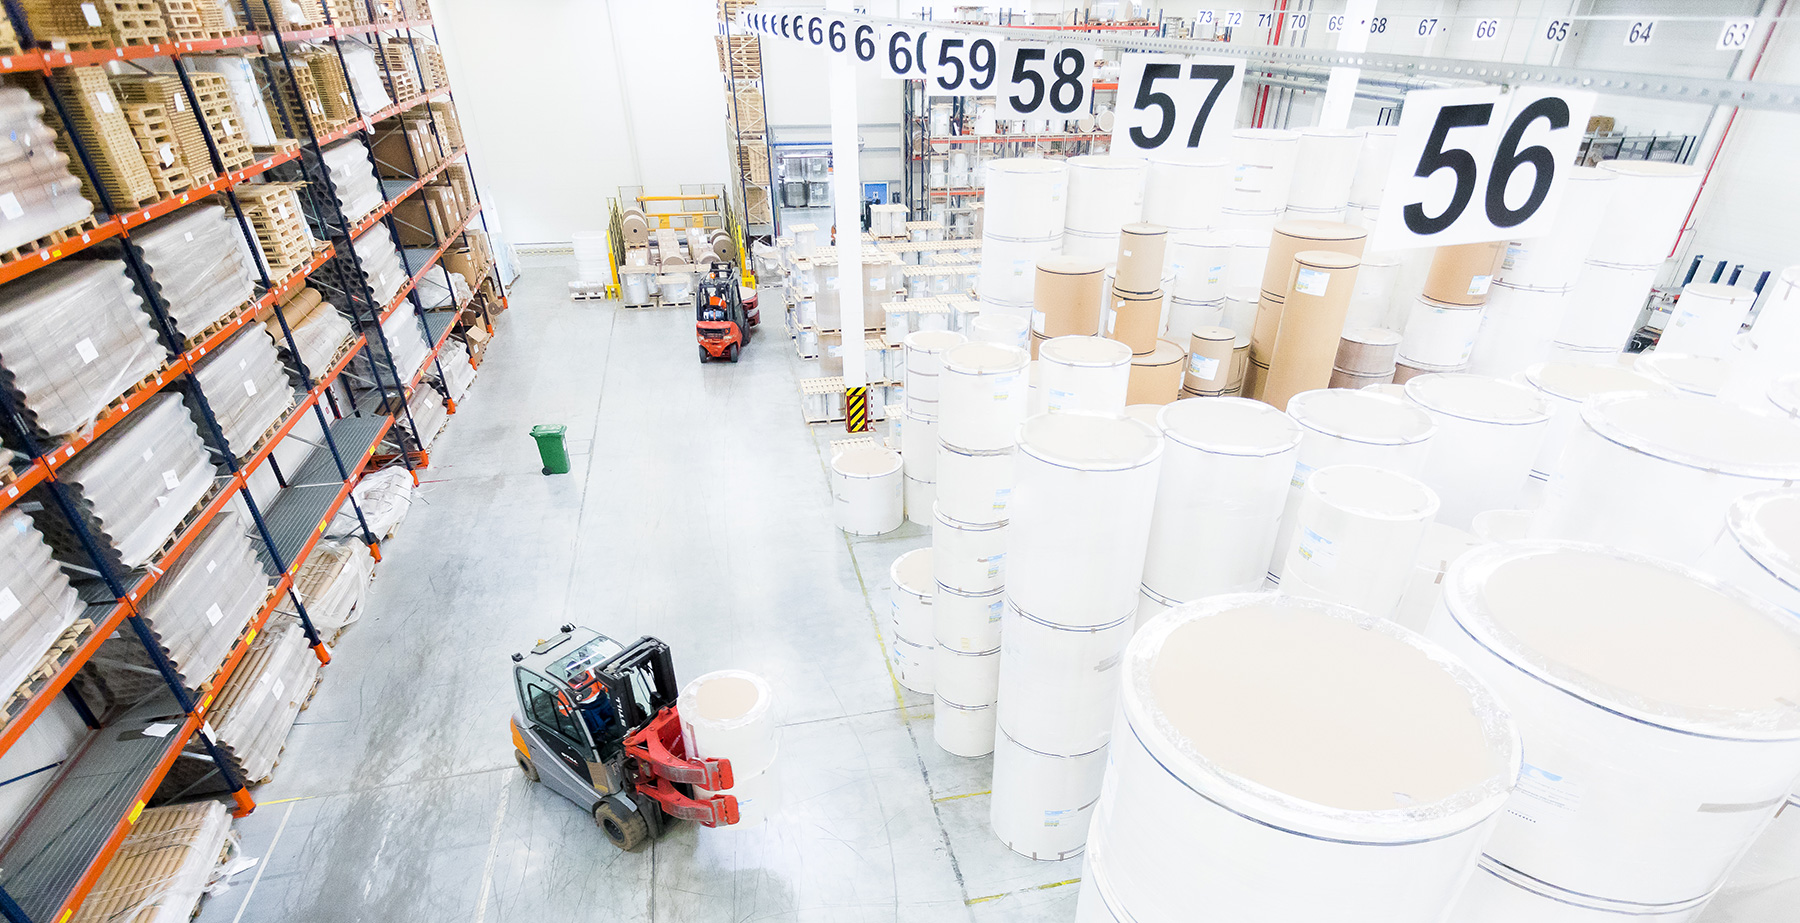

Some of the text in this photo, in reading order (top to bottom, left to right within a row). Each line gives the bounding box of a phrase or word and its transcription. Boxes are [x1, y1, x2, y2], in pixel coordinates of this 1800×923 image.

[1199, 11, 1213, 23] 73
[1228, 12, 1242, 25] 72
[1258, 13, 1272, 27] 71
[1291, 14, 1307, 29] 70
[1328, 16, 1344, 31] 69
[1370, 17, 1388, 34] 68
[1418, 18, 1438, 36] 67
[1476, 20, 1497, 38] 66
[1546, 20, 1570, 42] 65
[1629, 22, 1653, 43] 64
[1723, 23, 1749, 47] 63
[854, 24, 880, 62] 6
[936, 38, 997, 90] 59
[1009, 47, 1086, 114] 58
[1129, 63, 1236, 149] 57
[1398, 96, 1570, 235] 56
[615, 696, 627, 728] STILL
